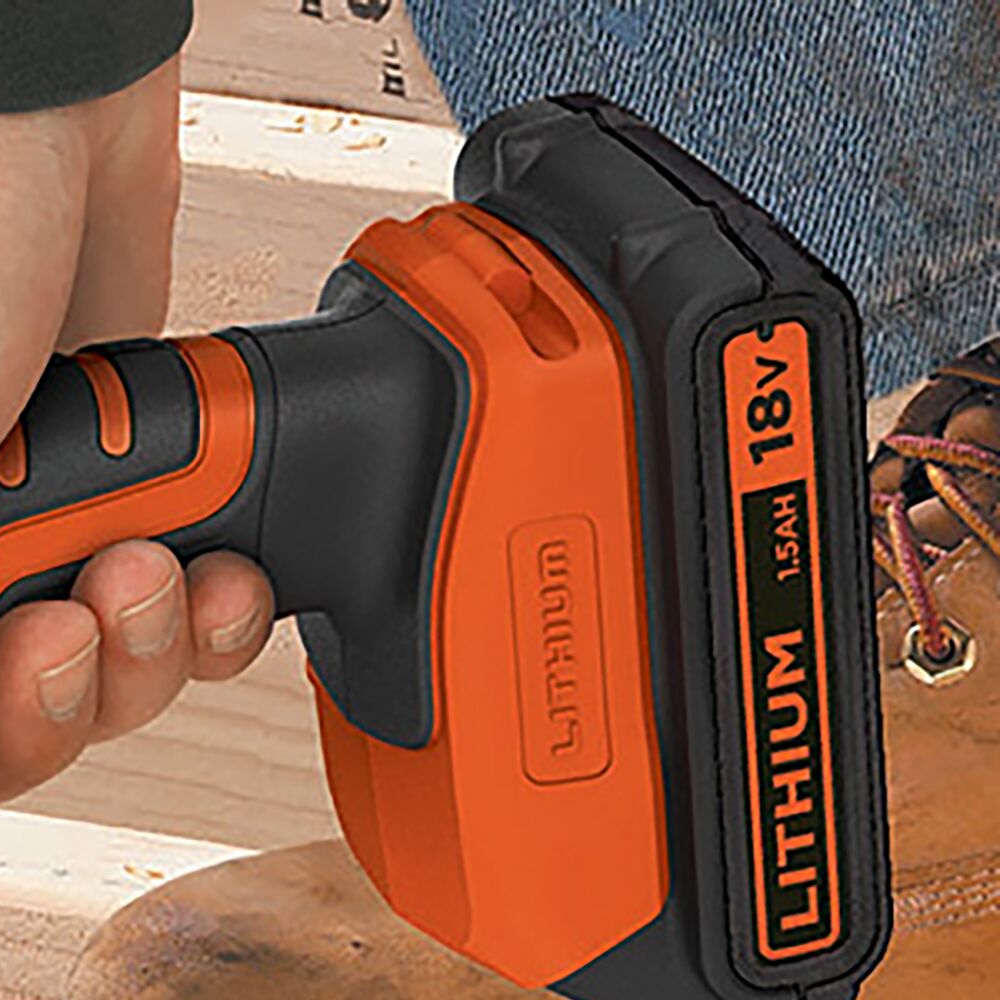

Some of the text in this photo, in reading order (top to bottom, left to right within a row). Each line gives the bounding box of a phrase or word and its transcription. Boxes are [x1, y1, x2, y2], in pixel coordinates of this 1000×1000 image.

[773, 492, 800, 582] 1.5AH
[537, 540, 581, 758] LITHIUM
[764, 629, 820, 932] LITHIUM
